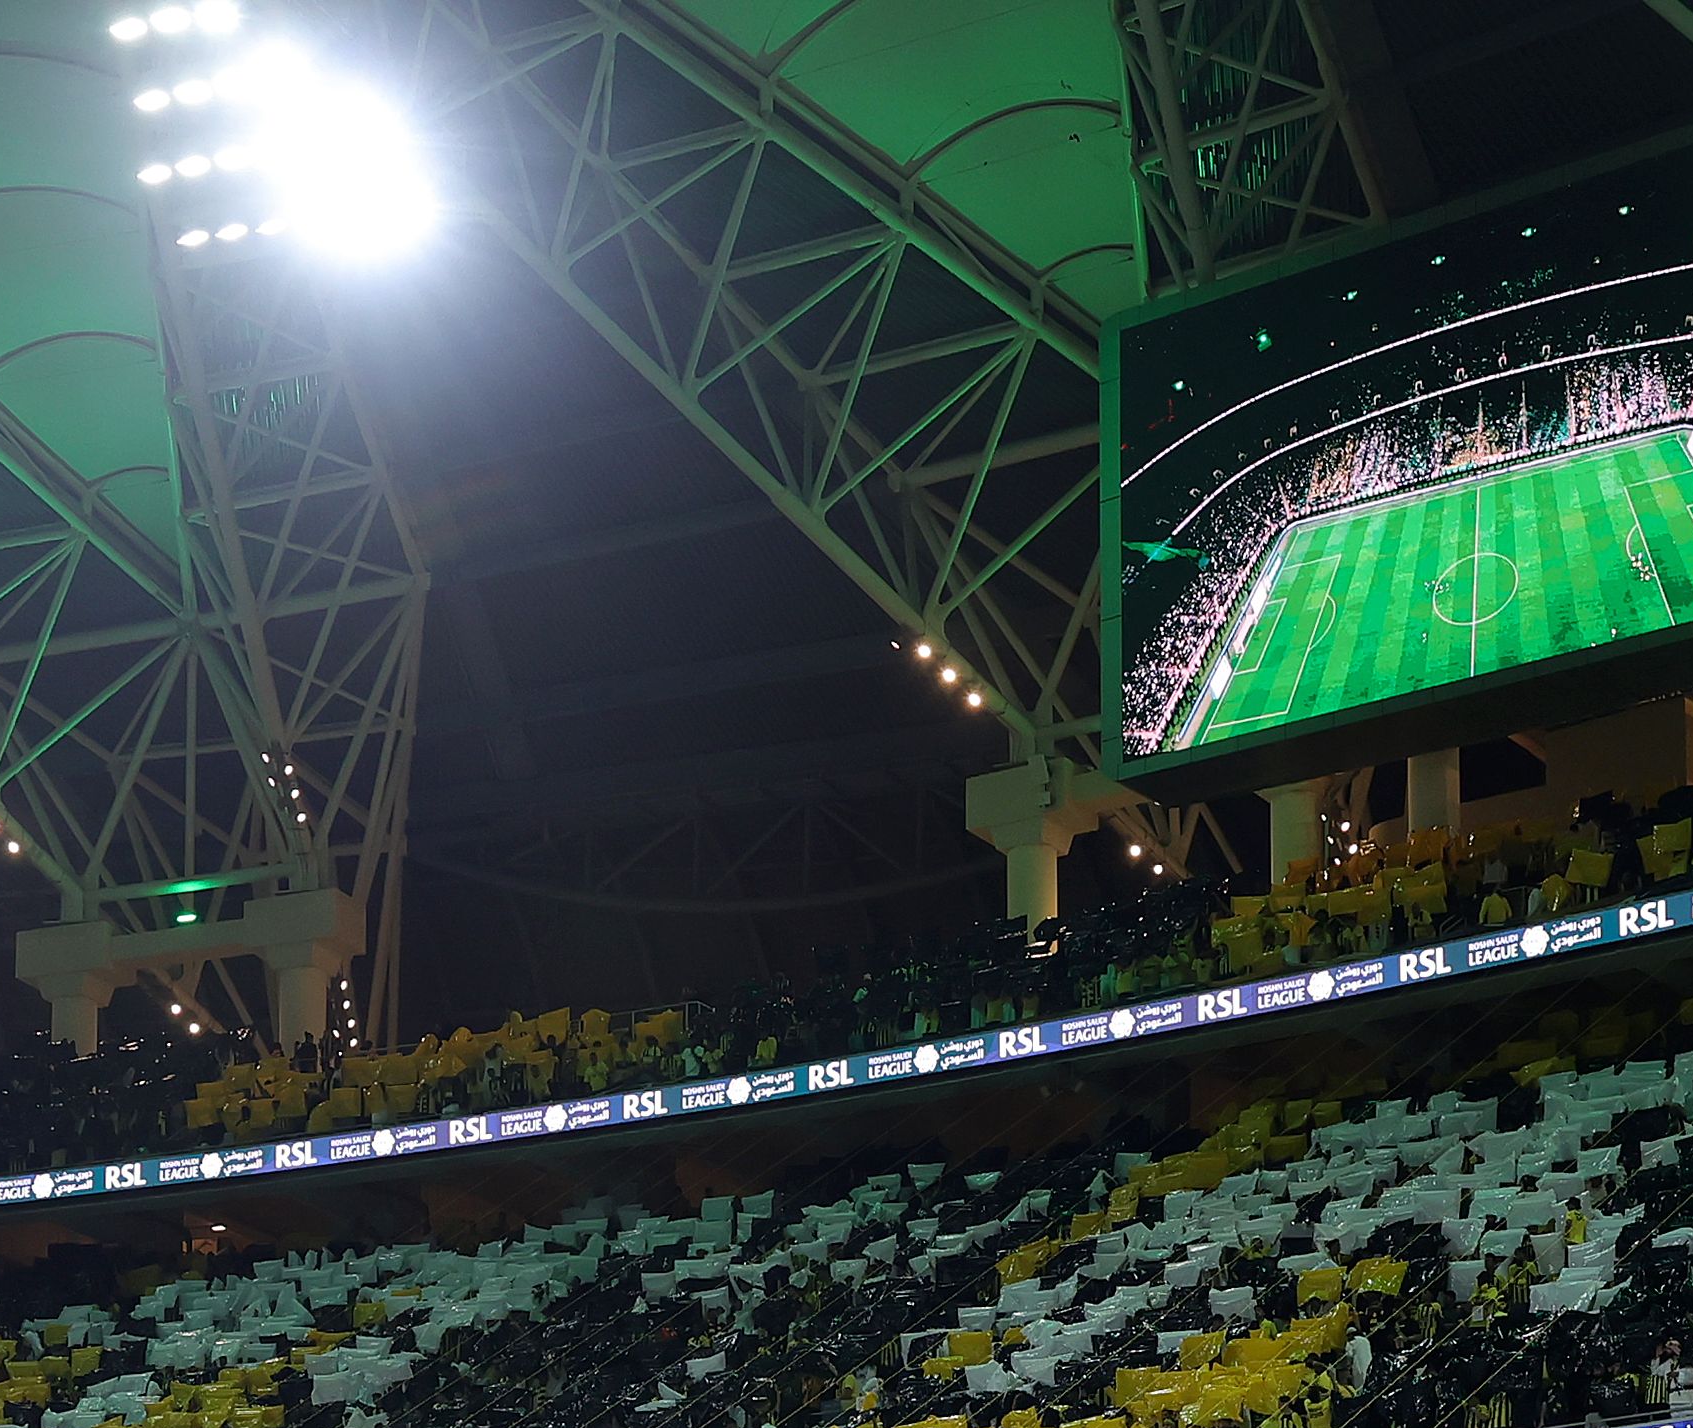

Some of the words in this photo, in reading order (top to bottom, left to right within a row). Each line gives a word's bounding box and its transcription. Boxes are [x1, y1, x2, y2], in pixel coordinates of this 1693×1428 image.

[1620, 900, 1673, 936] RSL
[1469, 943, 1518, 966] LEAGUE
[683, 1091, 725, 1109] LEAGUE
